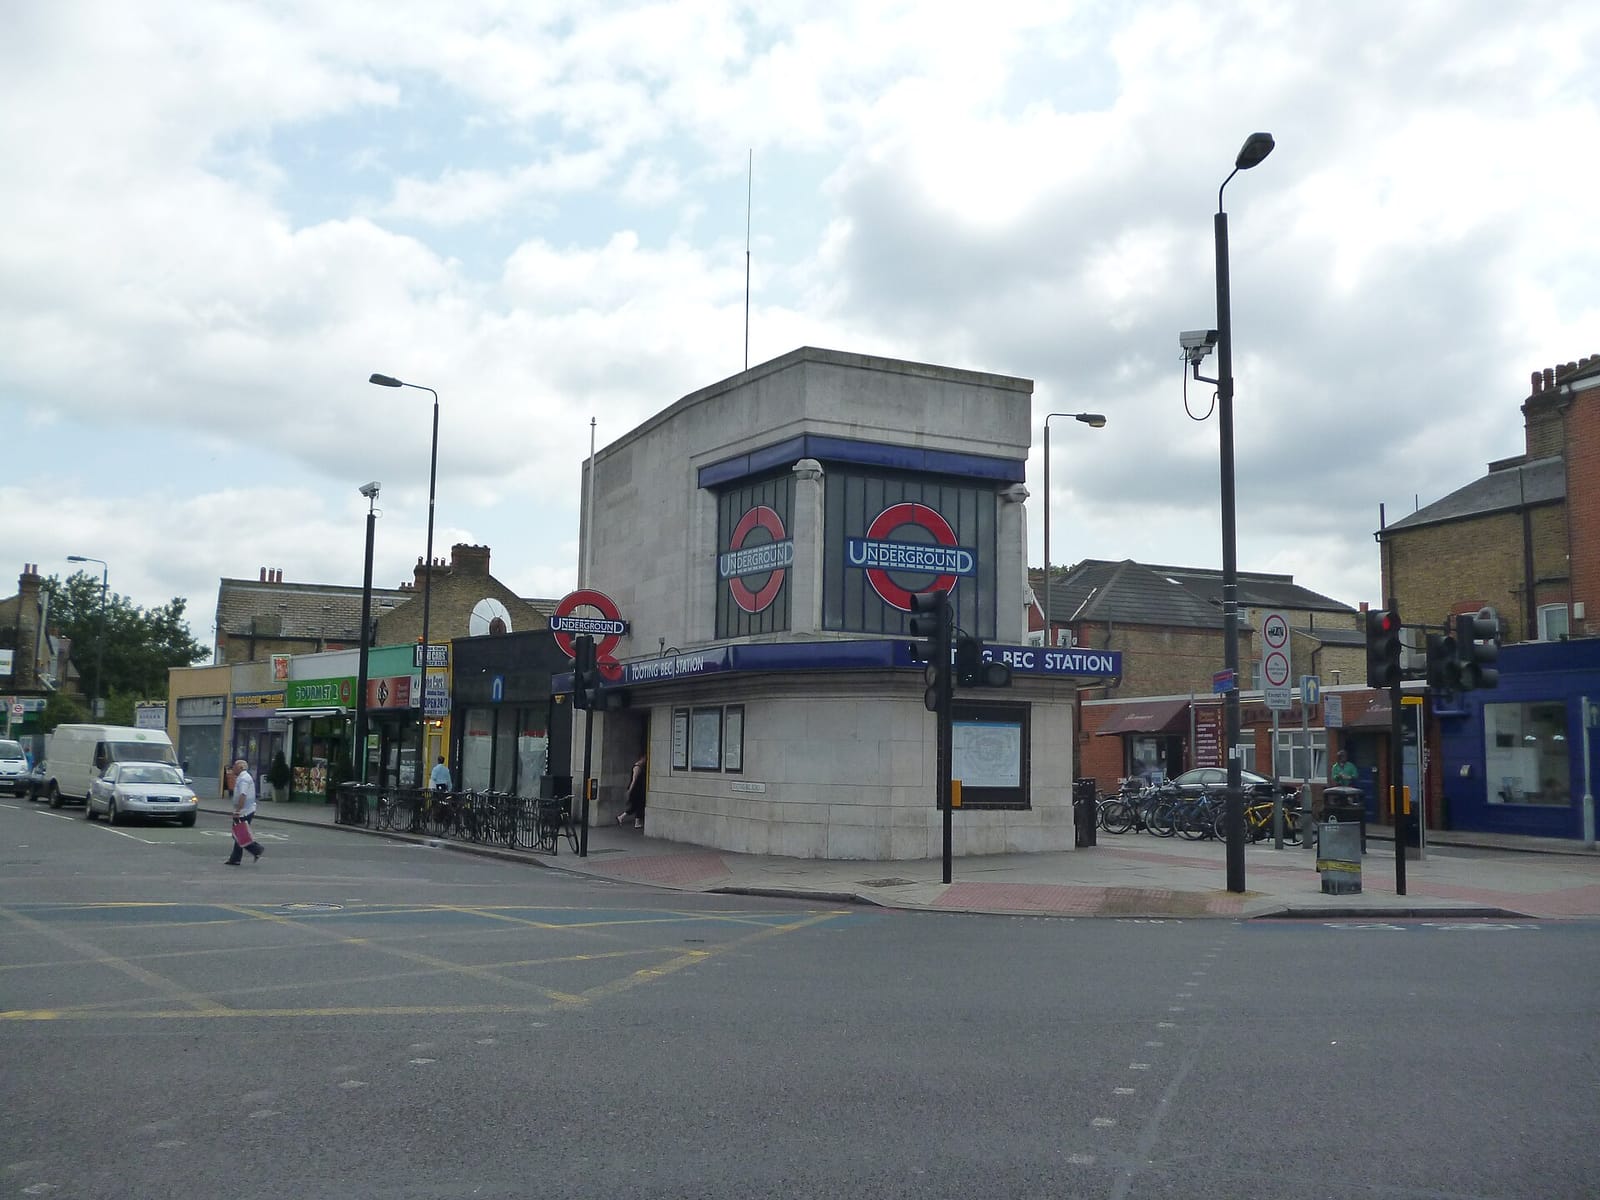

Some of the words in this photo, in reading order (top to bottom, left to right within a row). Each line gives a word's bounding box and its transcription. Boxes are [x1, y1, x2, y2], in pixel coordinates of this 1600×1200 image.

[720, 541, 794, 577] UNDERGROUND
[849, 540, 973, 573] UNDERGROUND
[550, 617, 624, 634] UNDERGROUND
[632, 663, 659, 681] TOOTING
[660, 661, 673, 676] BEC
[675, 656, 704, 674] STATION
[1003, 651, 1034, 669] BEC
[1045, 653, 1113, 672] STATION
